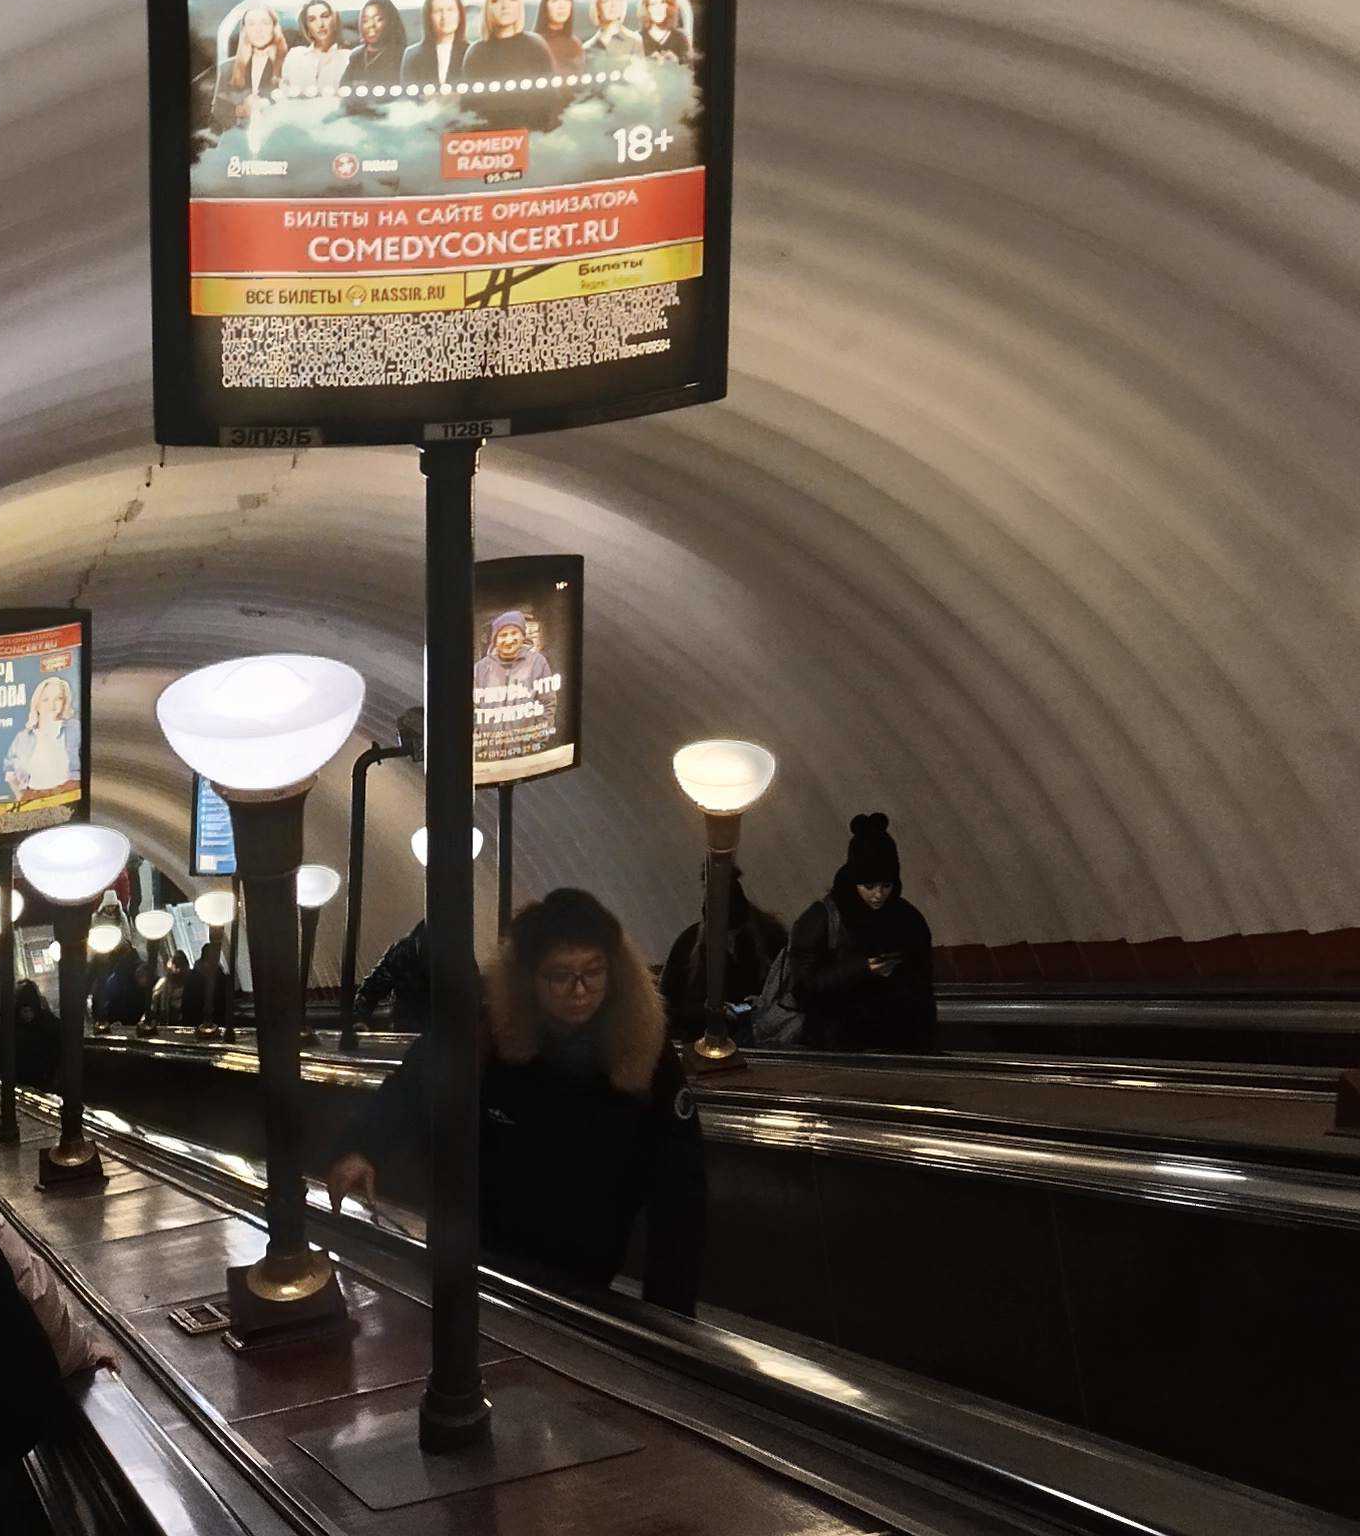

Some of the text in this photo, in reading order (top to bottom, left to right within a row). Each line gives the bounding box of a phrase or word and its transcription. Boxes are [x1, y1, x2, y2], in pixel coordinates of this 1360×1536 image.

[447, 135, 524, 155] COMEDY
[613, 124, 674, 164] 18+
[457, 154, 515, 172] RADIO
[284, 188, 638, 229] БИЛЕТЫ НА САЙТЕ ОРГАНИЗАТОРА
[307, 218, 620, 263] COMEDYCONCERT.RU
[578, 257, 643, 276] Билеты
[245, 289, 273, 305] ВСЕ
[278, 288, 342, 305] БИЛЕТЫ
[533, 673, 561, 694] ЧТО
